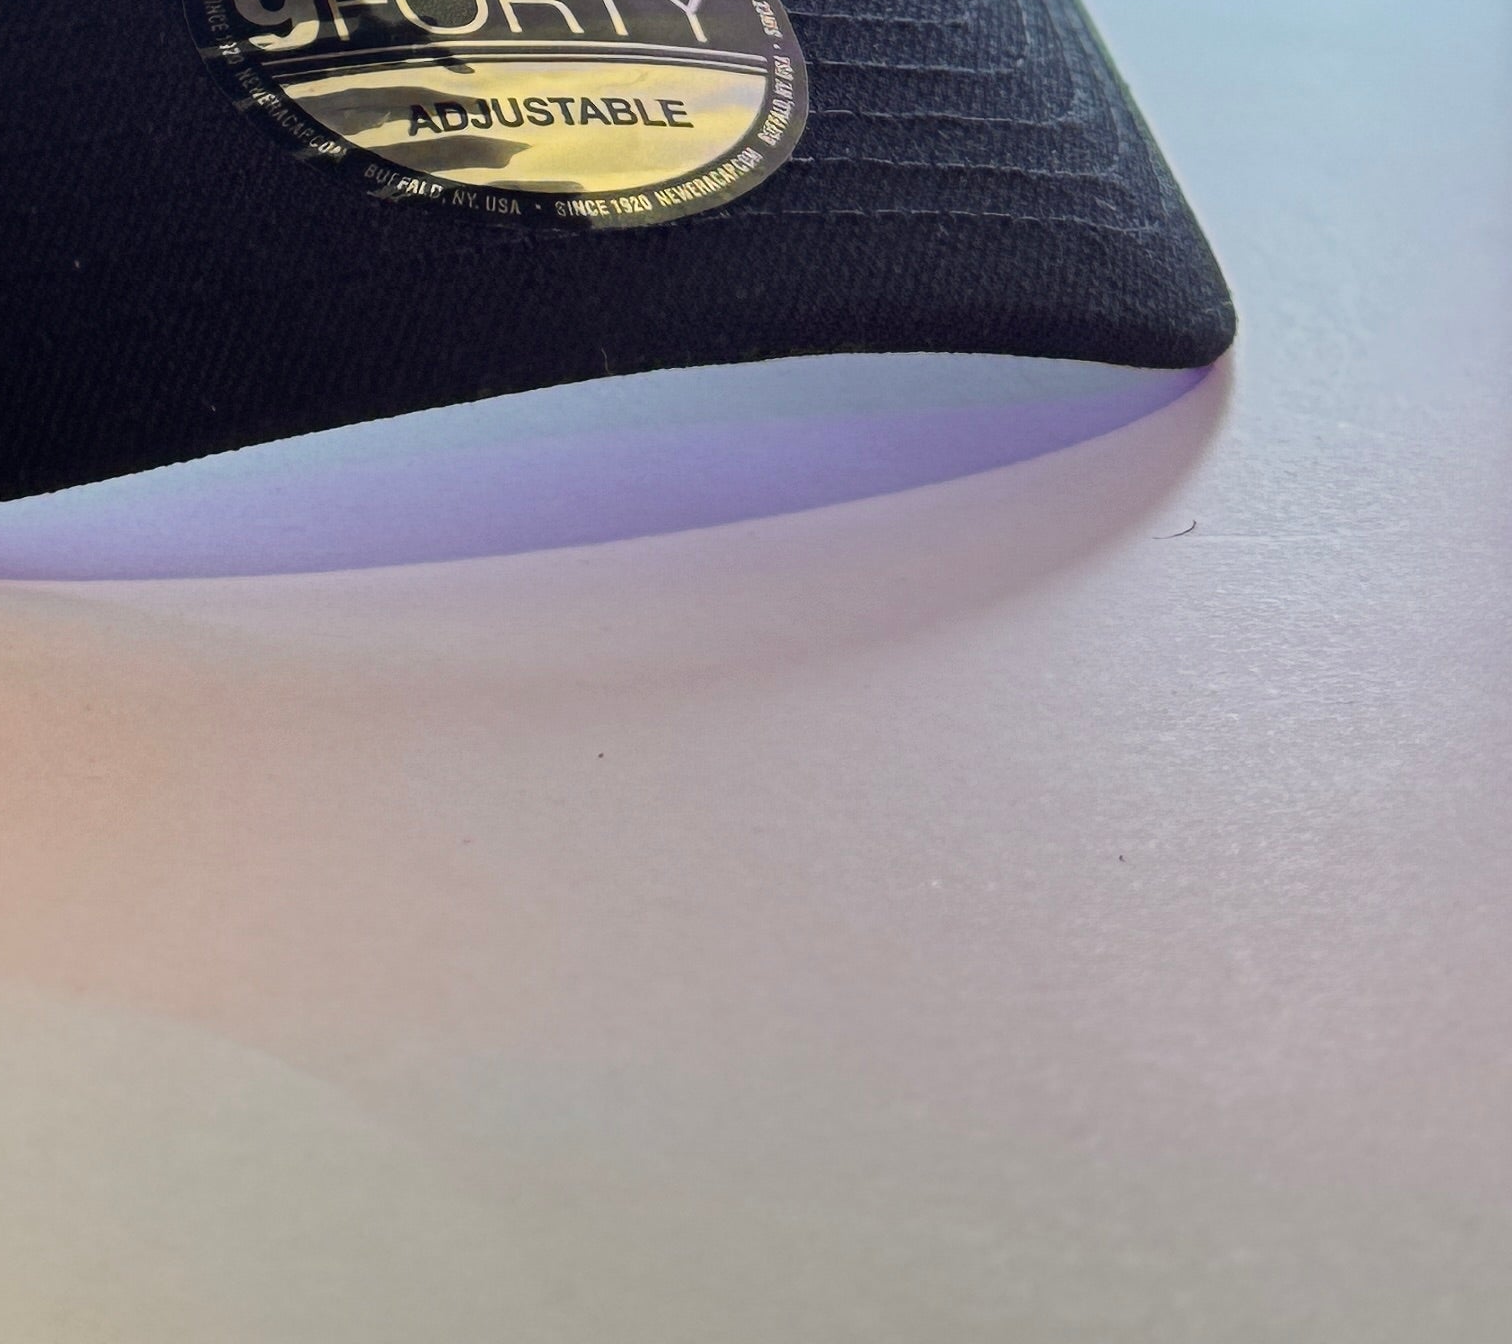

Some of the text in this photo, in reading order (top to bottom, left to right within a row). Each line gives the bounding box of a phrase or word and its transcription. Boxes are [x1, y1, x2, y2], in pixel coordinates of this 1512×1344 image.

[408, 96, 694, 137] ADJUSTABLE
[485, 194, 522, 216] USA
[554, 198, 610, 218] SINCE
[609, 193, 653, 214] 1920
